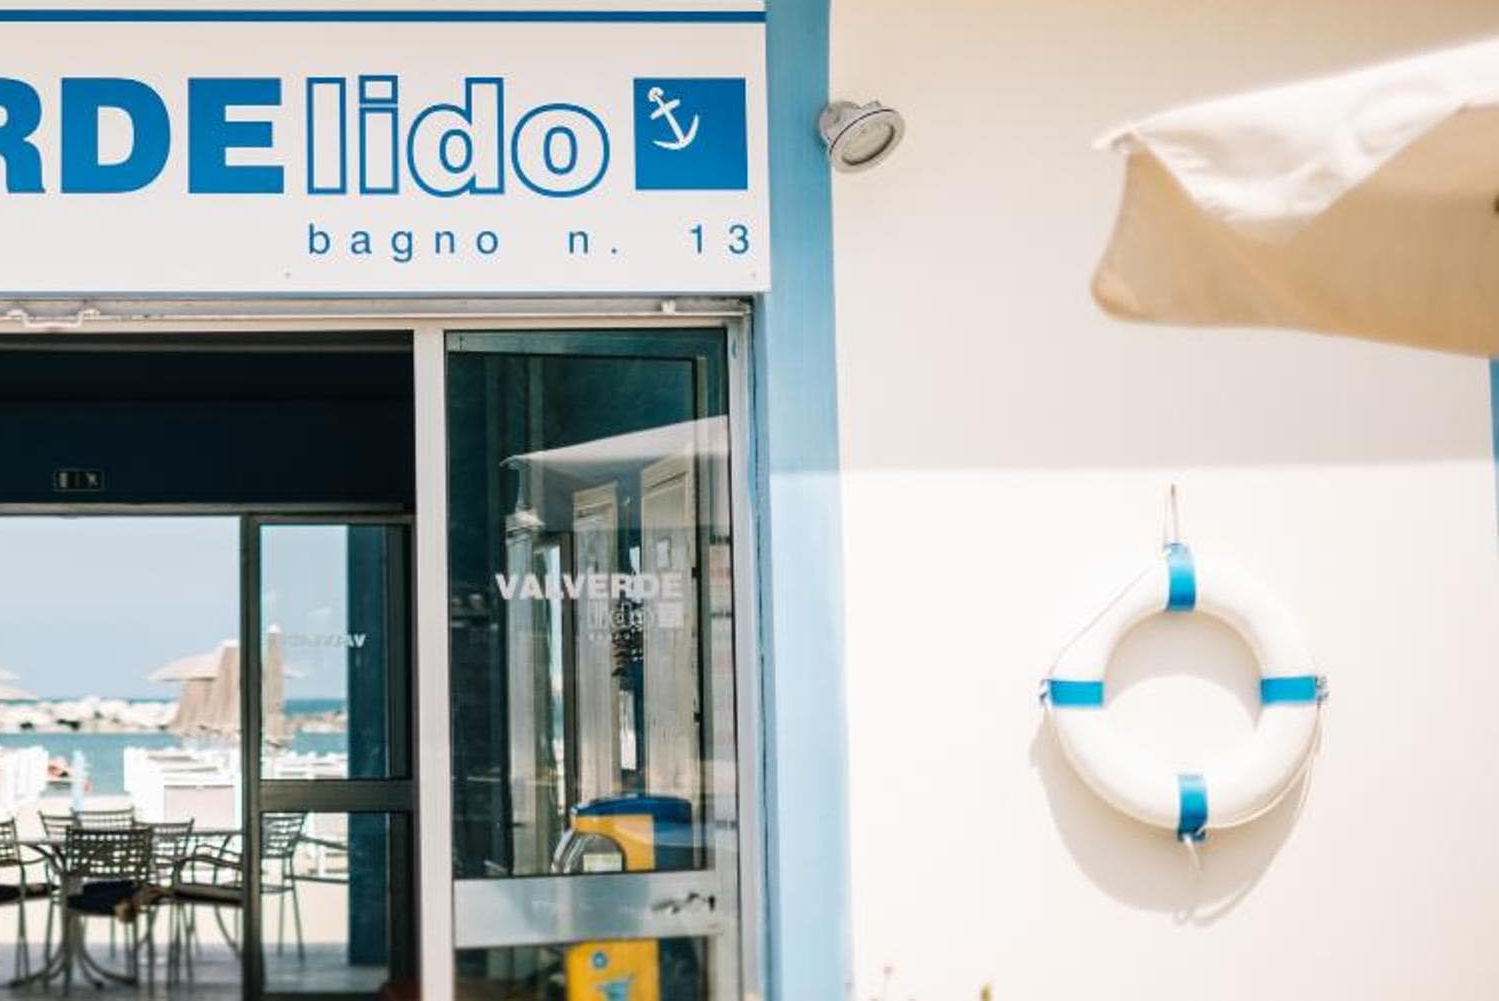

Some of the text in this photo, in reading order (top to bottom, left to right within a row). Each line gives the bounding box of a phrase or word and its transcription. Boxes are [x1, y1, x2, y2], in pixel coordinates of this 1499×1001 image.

[307, 223, 750, 262] bagno n. 13
[496, 573, 683, 600] VALVERDE
